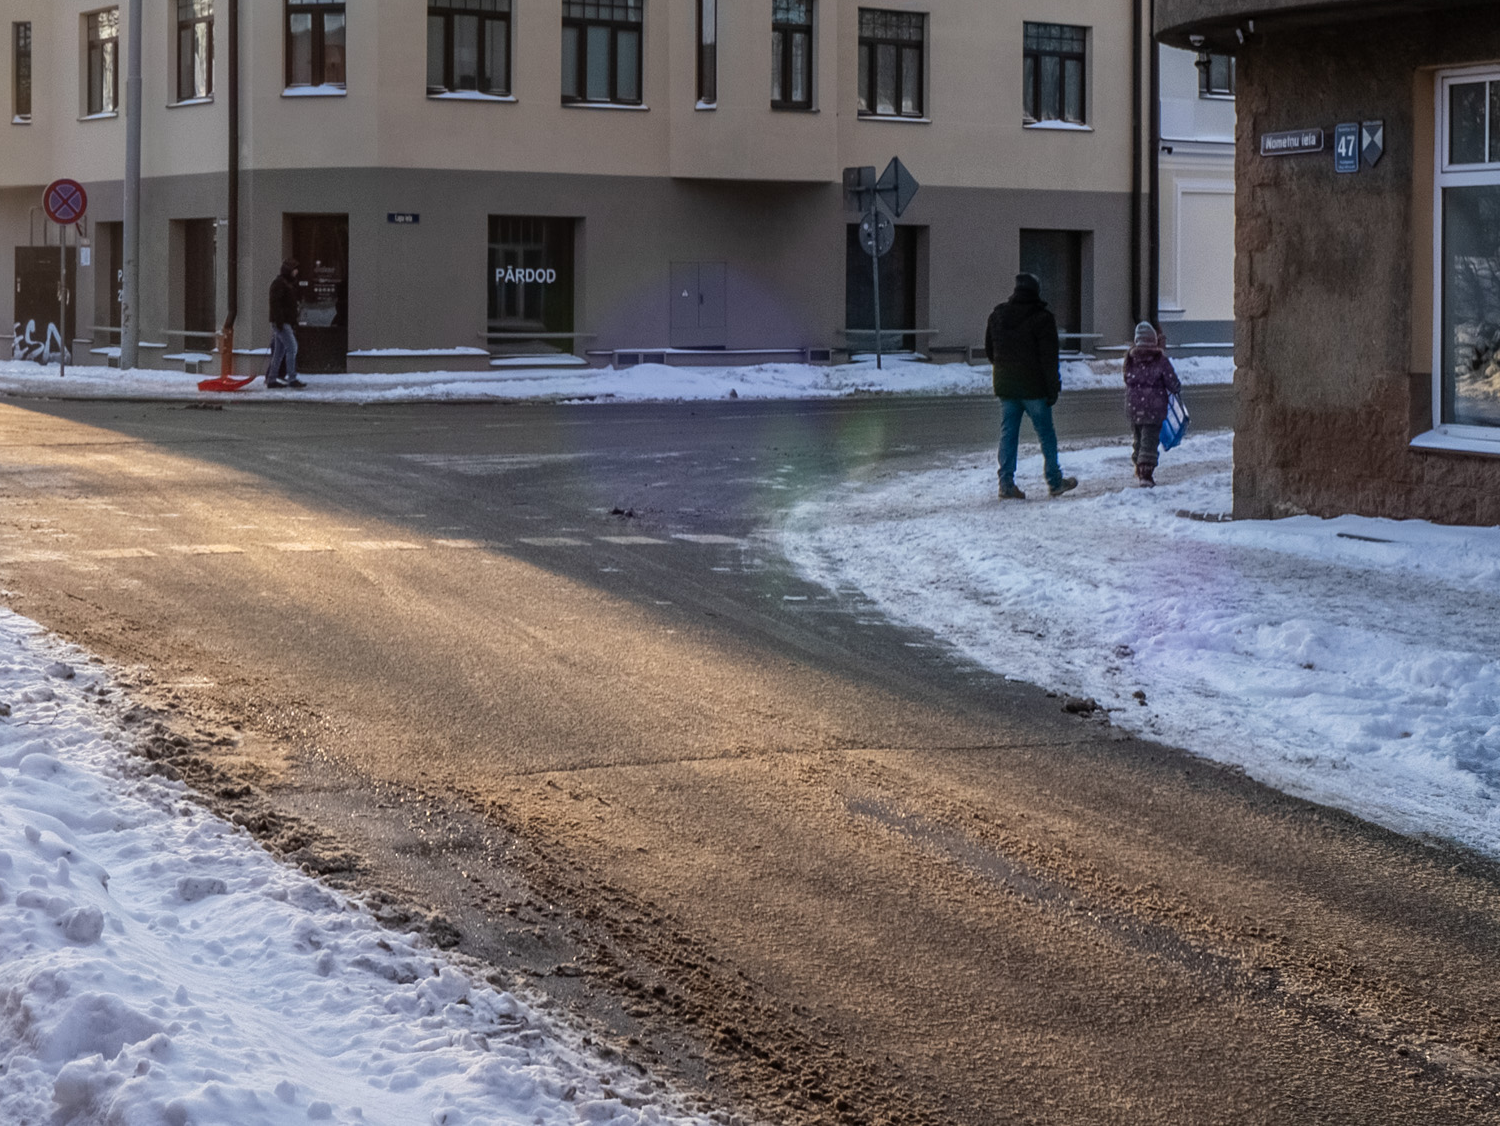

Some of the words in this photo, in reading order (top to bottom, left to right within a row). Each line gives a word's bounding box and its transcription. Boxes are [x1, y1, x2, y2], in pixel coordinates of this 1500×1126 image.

[1301, 133, 1316, 146] iela
[1337, 135, 1355, 157] 47
[495, 265, 557, 285] PĀRDOD
